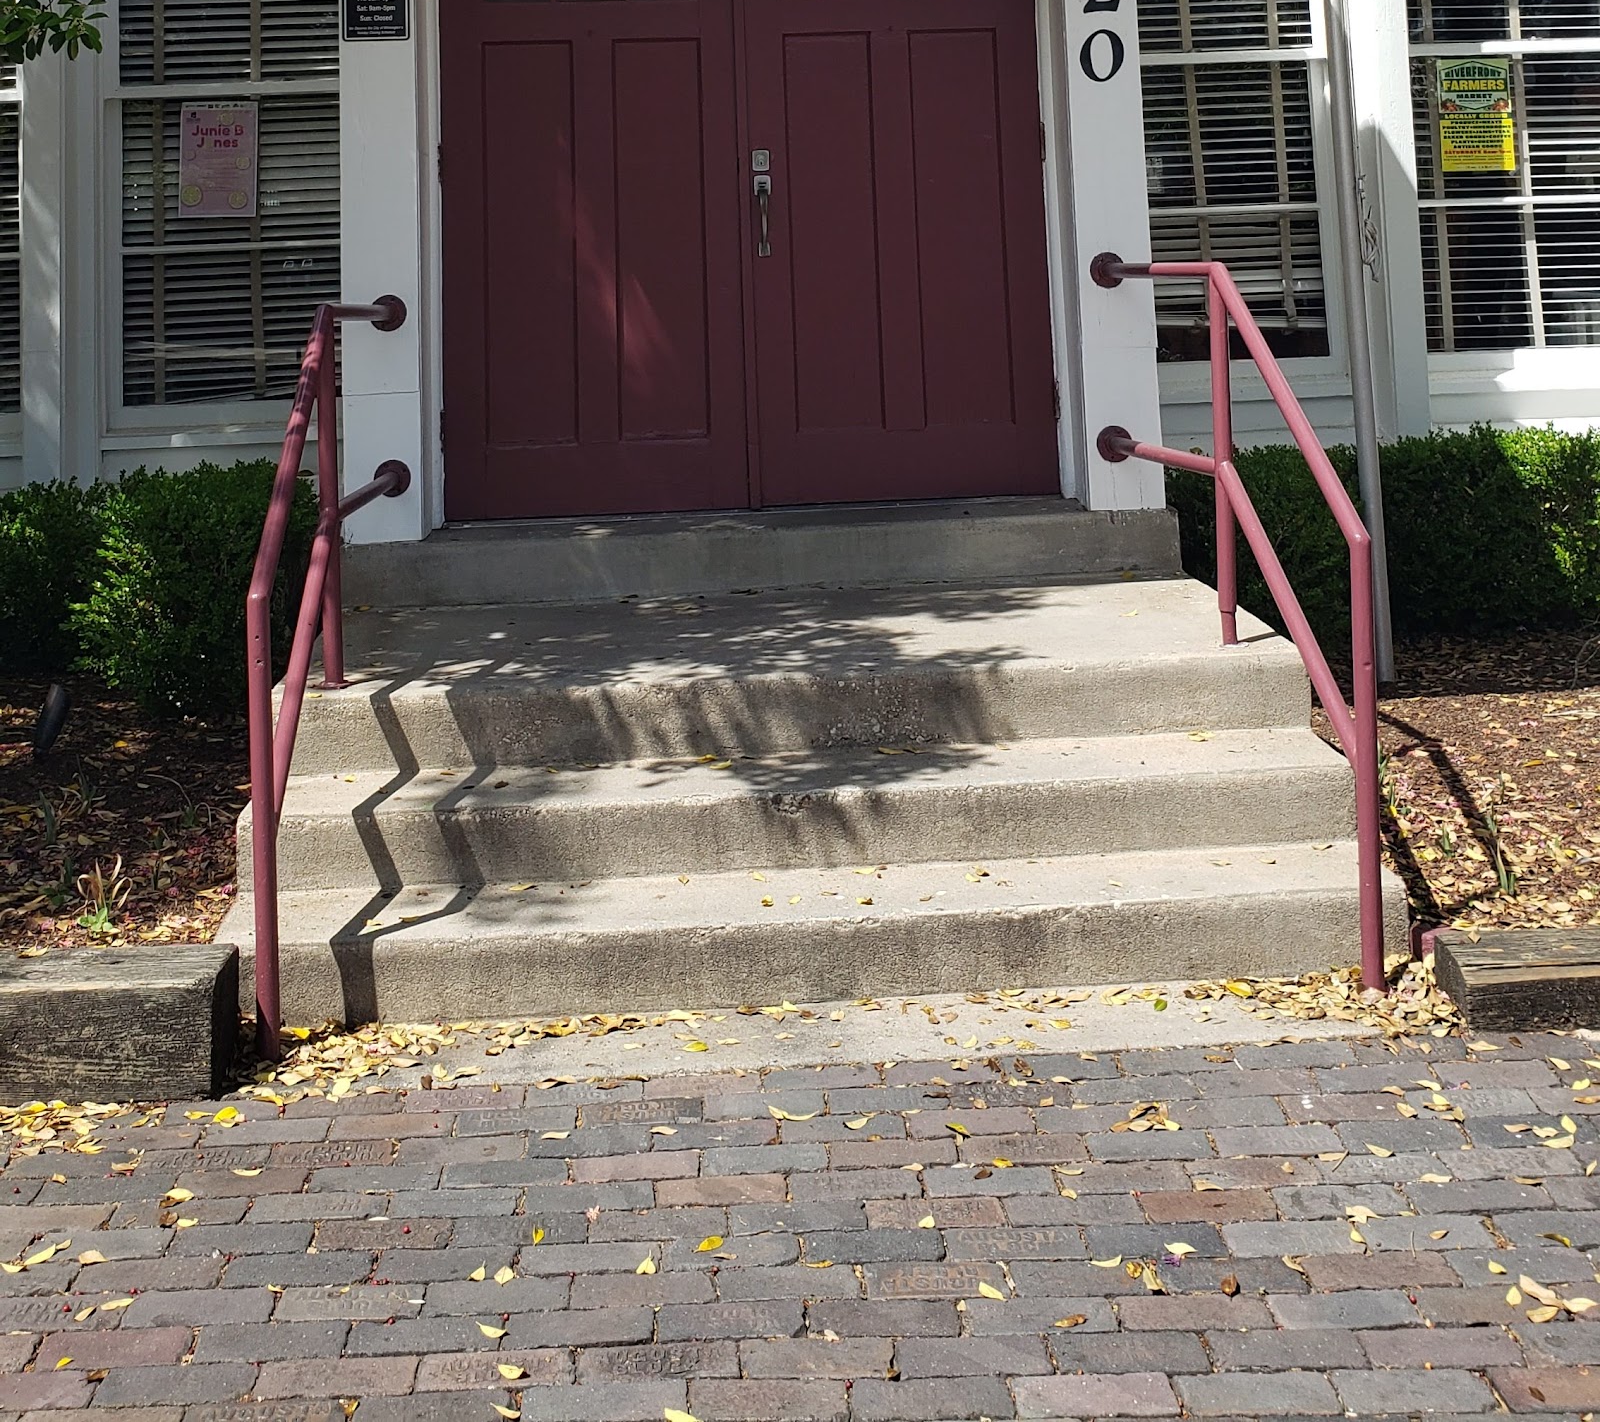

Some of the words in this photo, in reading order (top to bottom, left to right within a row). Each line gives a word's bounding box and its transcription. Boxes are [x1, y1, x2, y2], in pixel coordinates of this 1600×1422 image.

[1444, 65, 1502, 78] RIVERFRONT
[1442, 80, 1505, 90] FARMERS
[192, 124, 230, 136] Junie
[234, 124, 244, 136] B
[196, 137, 238, 148] Jnes
